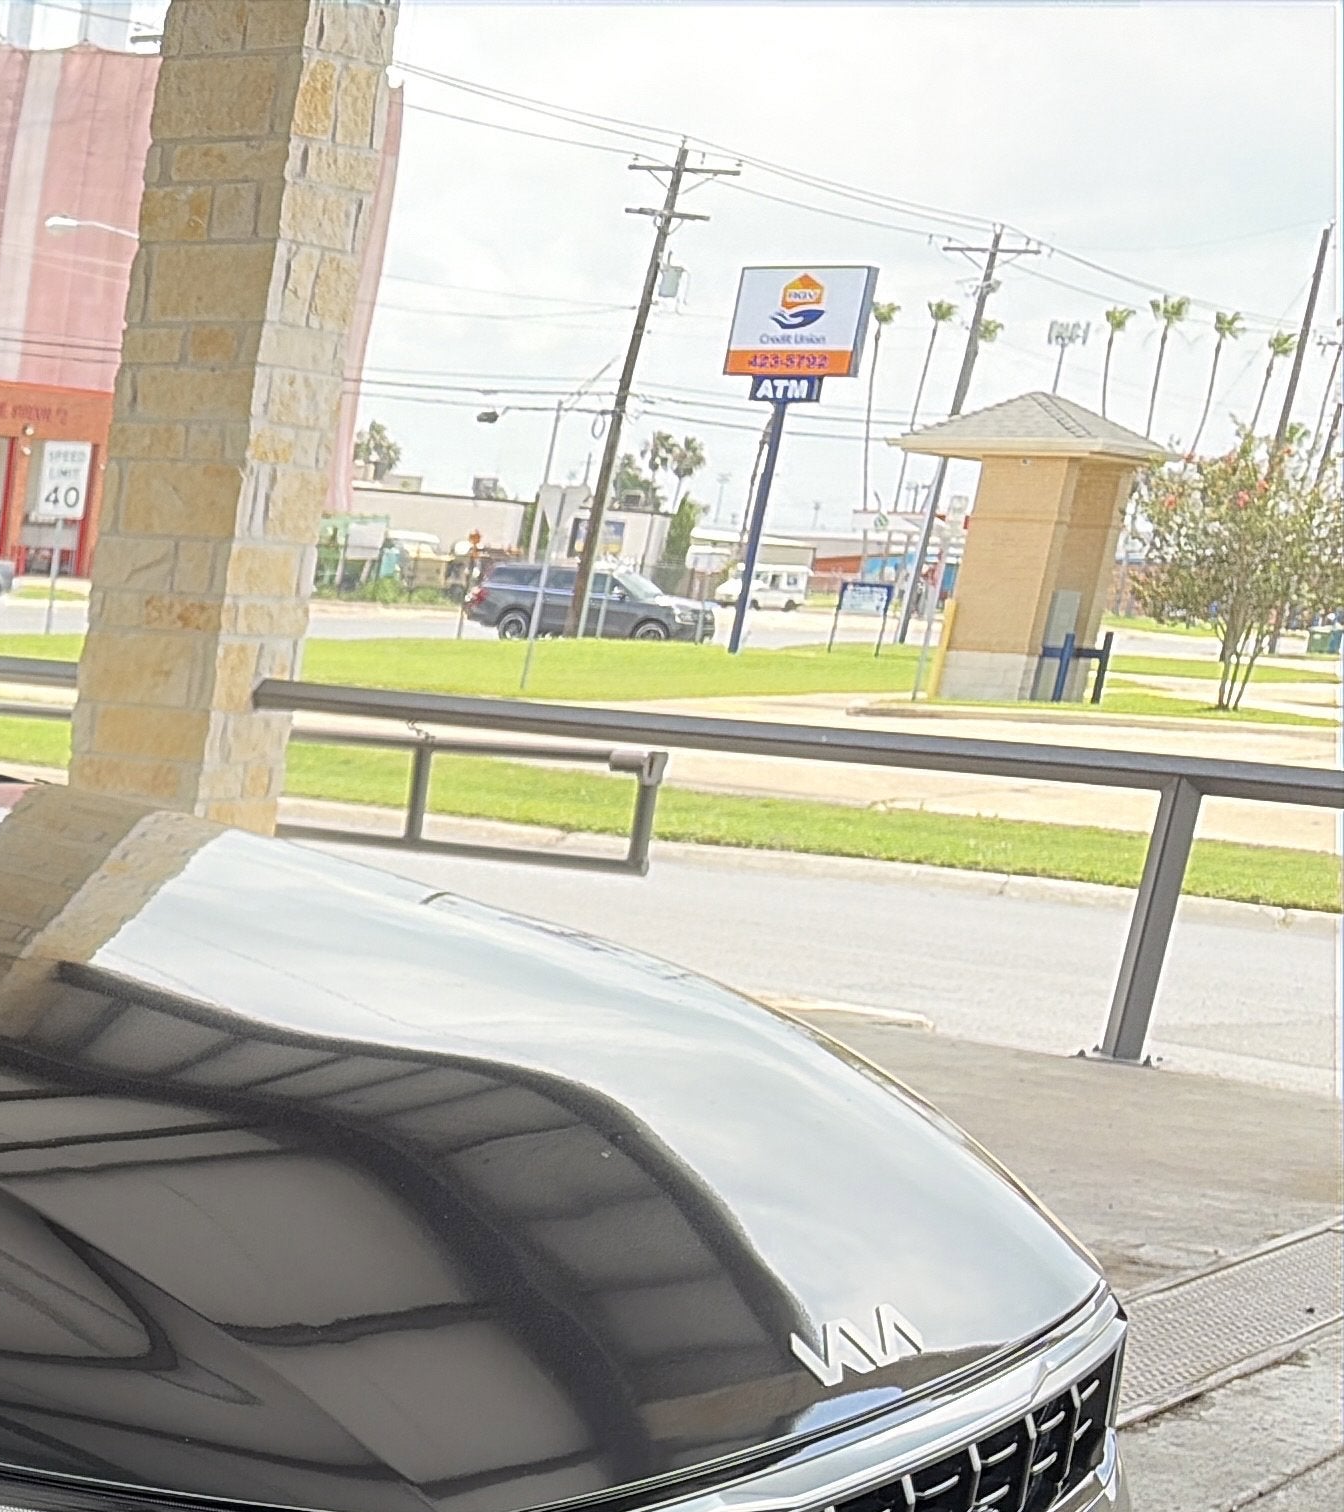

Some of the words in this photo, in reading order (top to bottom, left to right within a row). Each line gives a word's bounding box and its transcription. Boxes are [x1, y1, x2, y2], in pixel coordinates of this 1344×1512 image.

[756, 378, 809, 399] ATM
[48, 449, 87, 464] SPEED
[44, 486, 80, 508] 40
